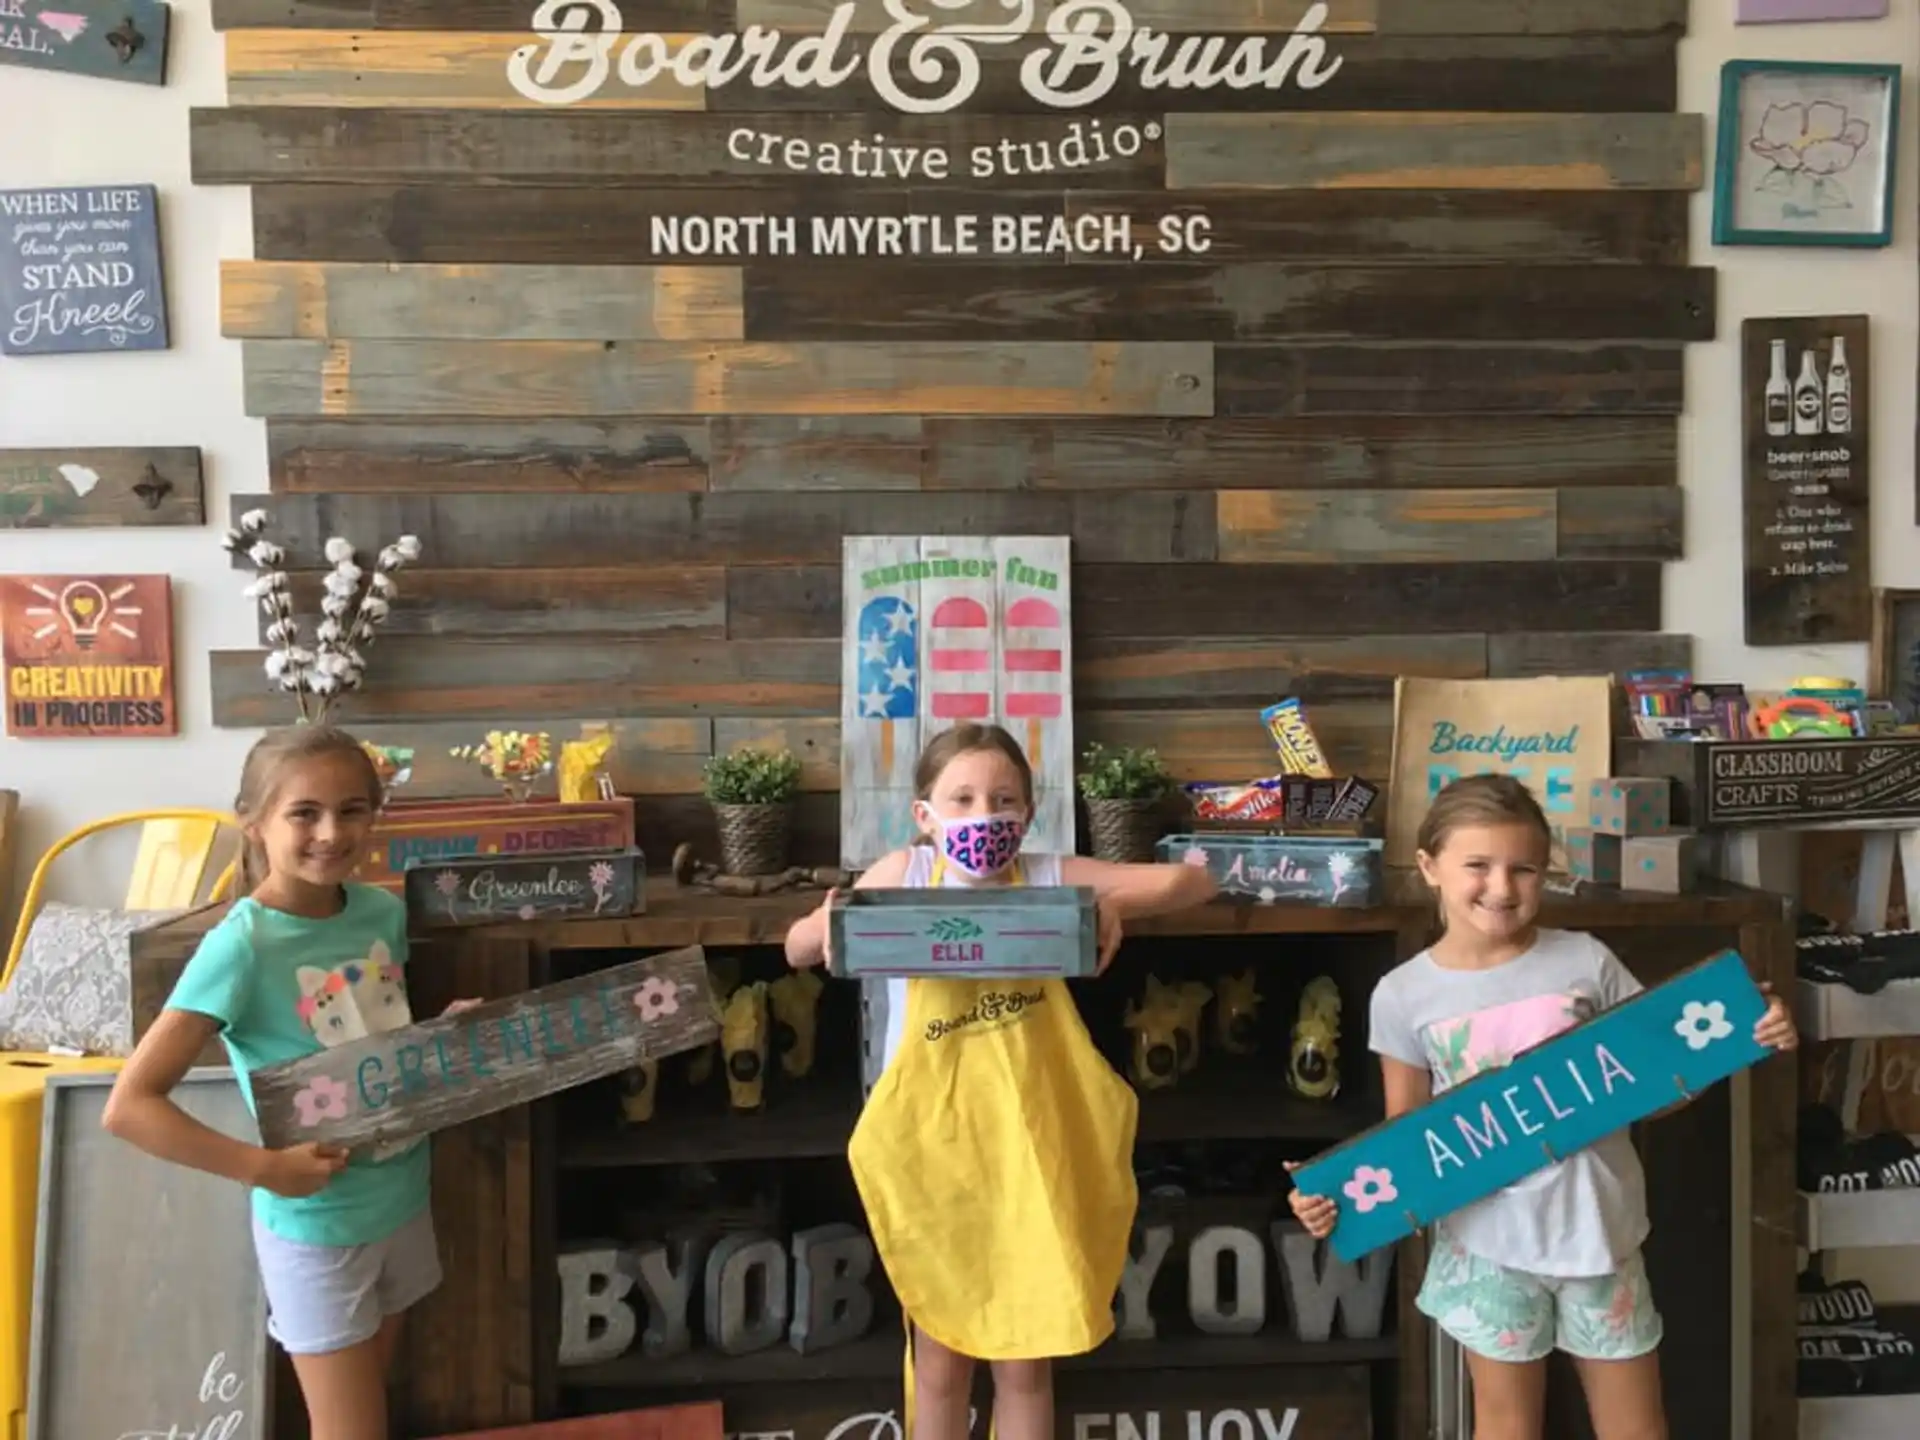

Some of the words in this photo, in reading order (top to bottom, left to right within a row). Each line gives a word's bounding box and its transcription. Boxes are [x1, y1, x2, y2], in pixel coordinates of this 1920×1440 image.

[507, 0, 861, 107] Board
[1020, 0, 1342, 108] Brush
[727, 127, 949, 180] creative
[1, 191, 78, 216] WHEN
[87, 190, 141, 213] LIFE
[650, 215, 797, 256] NORTH
[811, 214, 979, 255] MYRTLE
[991, 214, 1143, 260] BEACH,
[1157, 214, 1212, 253] SC
[22, 261, 134, 291] STAND
[861, 560, 997, 589] summer
[1006, 556, 1057, 591] fun
[10, 666, 164, 697] CREATIVITY
[14, 702, 37, 727] IN
[46, 702, 165, 727] PROGRESS
[1429, 721, 1579, 761] Backyard
[1716, 751, 1844, 777] CLASSROOM
[1716, 784, 1799, 806] CRAFTS
[1221, 853, 1312, 886] Amelia
[931, 943, 984, 962] ELLA
[1422, 1042, 1636, 1179] AMELIA
[557, 1222, 876, 1367] BYOB
[199, 1351, 244, 1403] be
